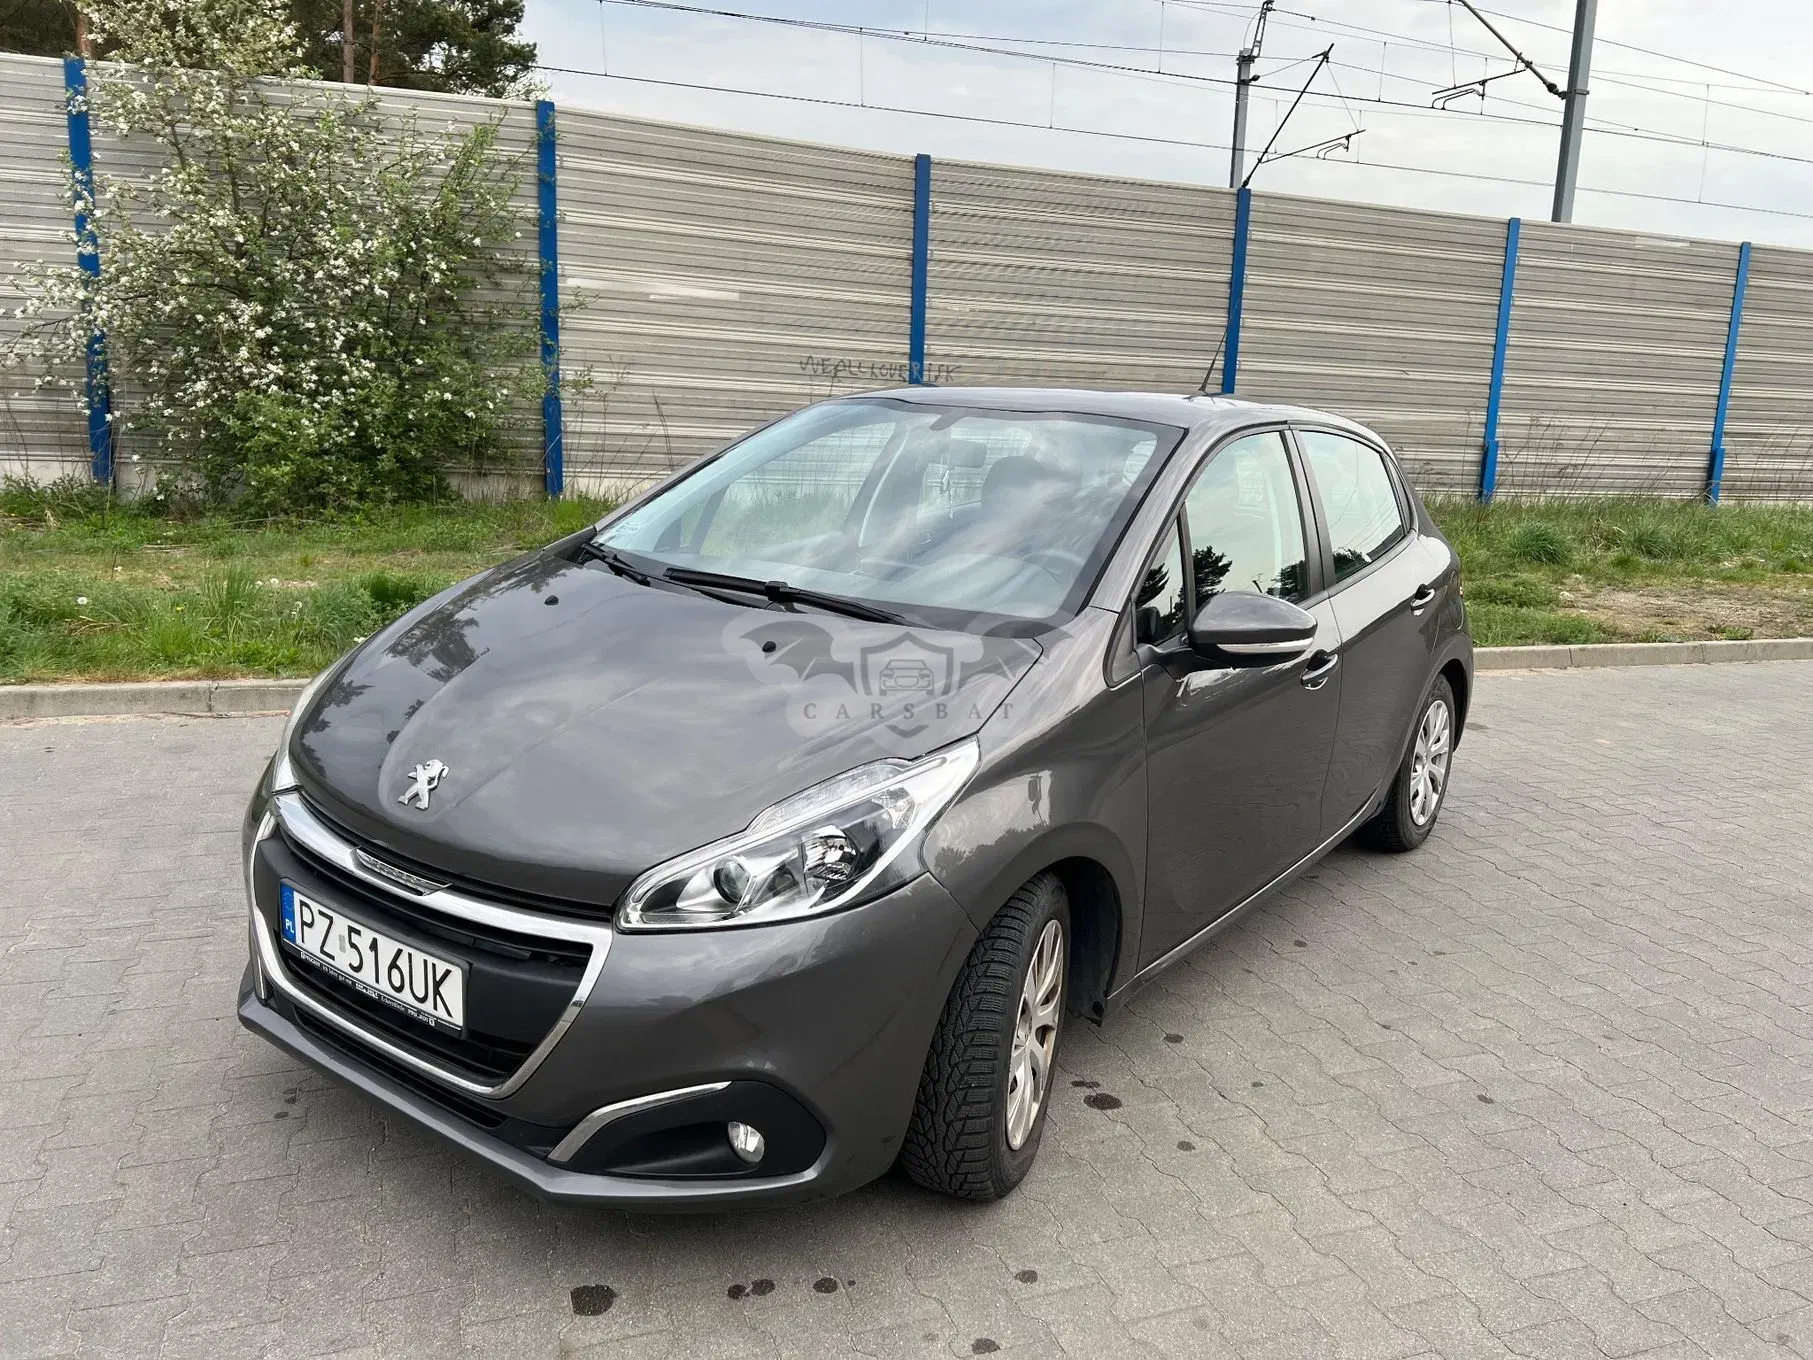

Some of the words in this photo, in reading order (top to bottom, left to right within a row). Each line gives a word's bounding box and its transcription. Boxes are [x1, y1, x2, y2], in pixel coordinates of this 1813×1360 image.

[285, 917, 295, 934] PL
[299, 898, 336, 962] PZ
[346, 924, 454, 1019] 516UK
